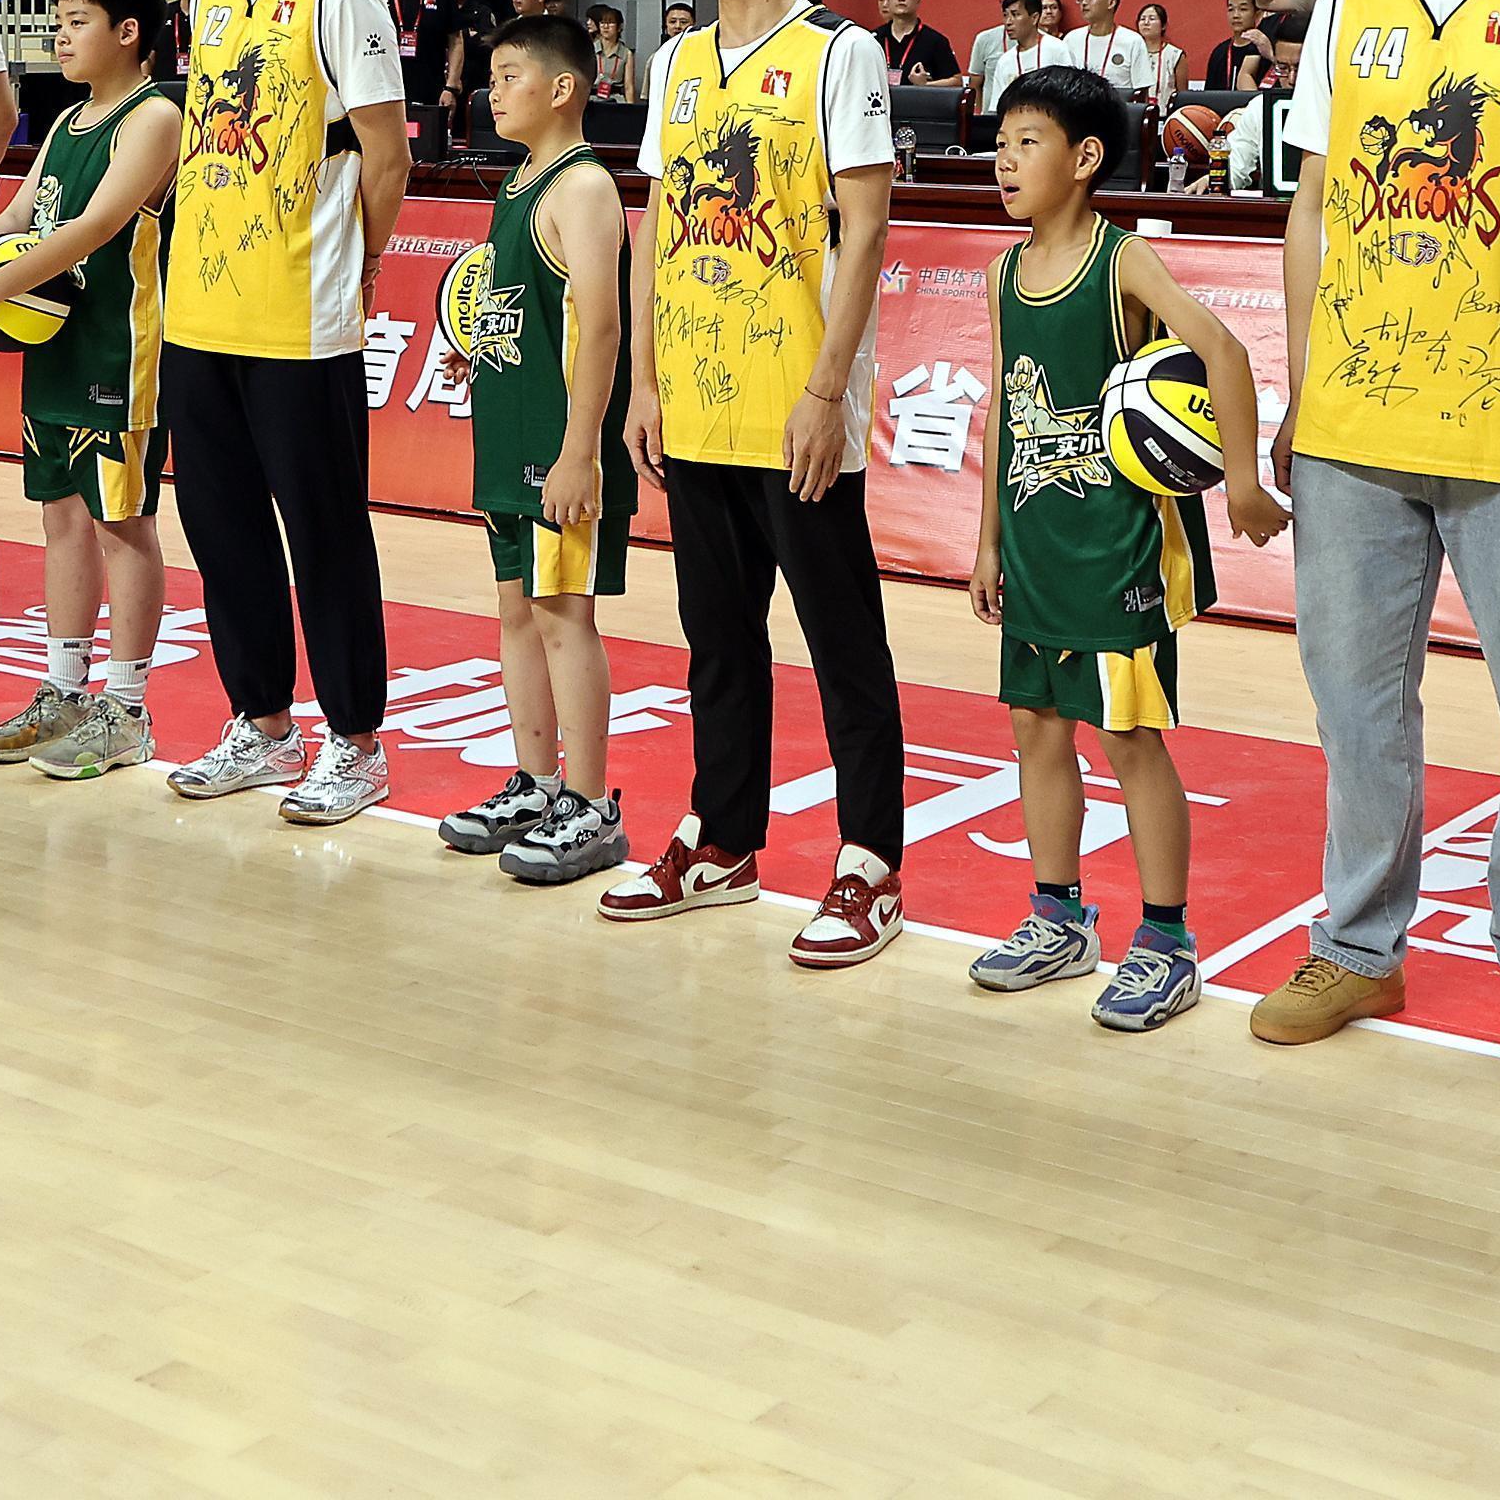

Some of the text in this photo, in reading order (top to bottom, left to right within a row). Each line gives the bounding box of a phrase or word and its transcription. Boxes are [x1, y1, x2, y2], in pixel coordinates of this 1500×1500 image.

[199, 4, 233, 47] 12
[1349, 26, 1409, 80] 44
[668, 76, 701, 125] 15
[863, 109, 888, 118] KELM
[666, 193, 777, 267] DRAGONS
[1388, 230, 1442, 267] 江苏
[456, 262, 482, 337] molten
[915, 287, 940, 296] CHINA
[941, 288, 972, 299] SPORTS
[917, 266, 985, 288] 中国体育
[889, 361, 988, 473] 省
